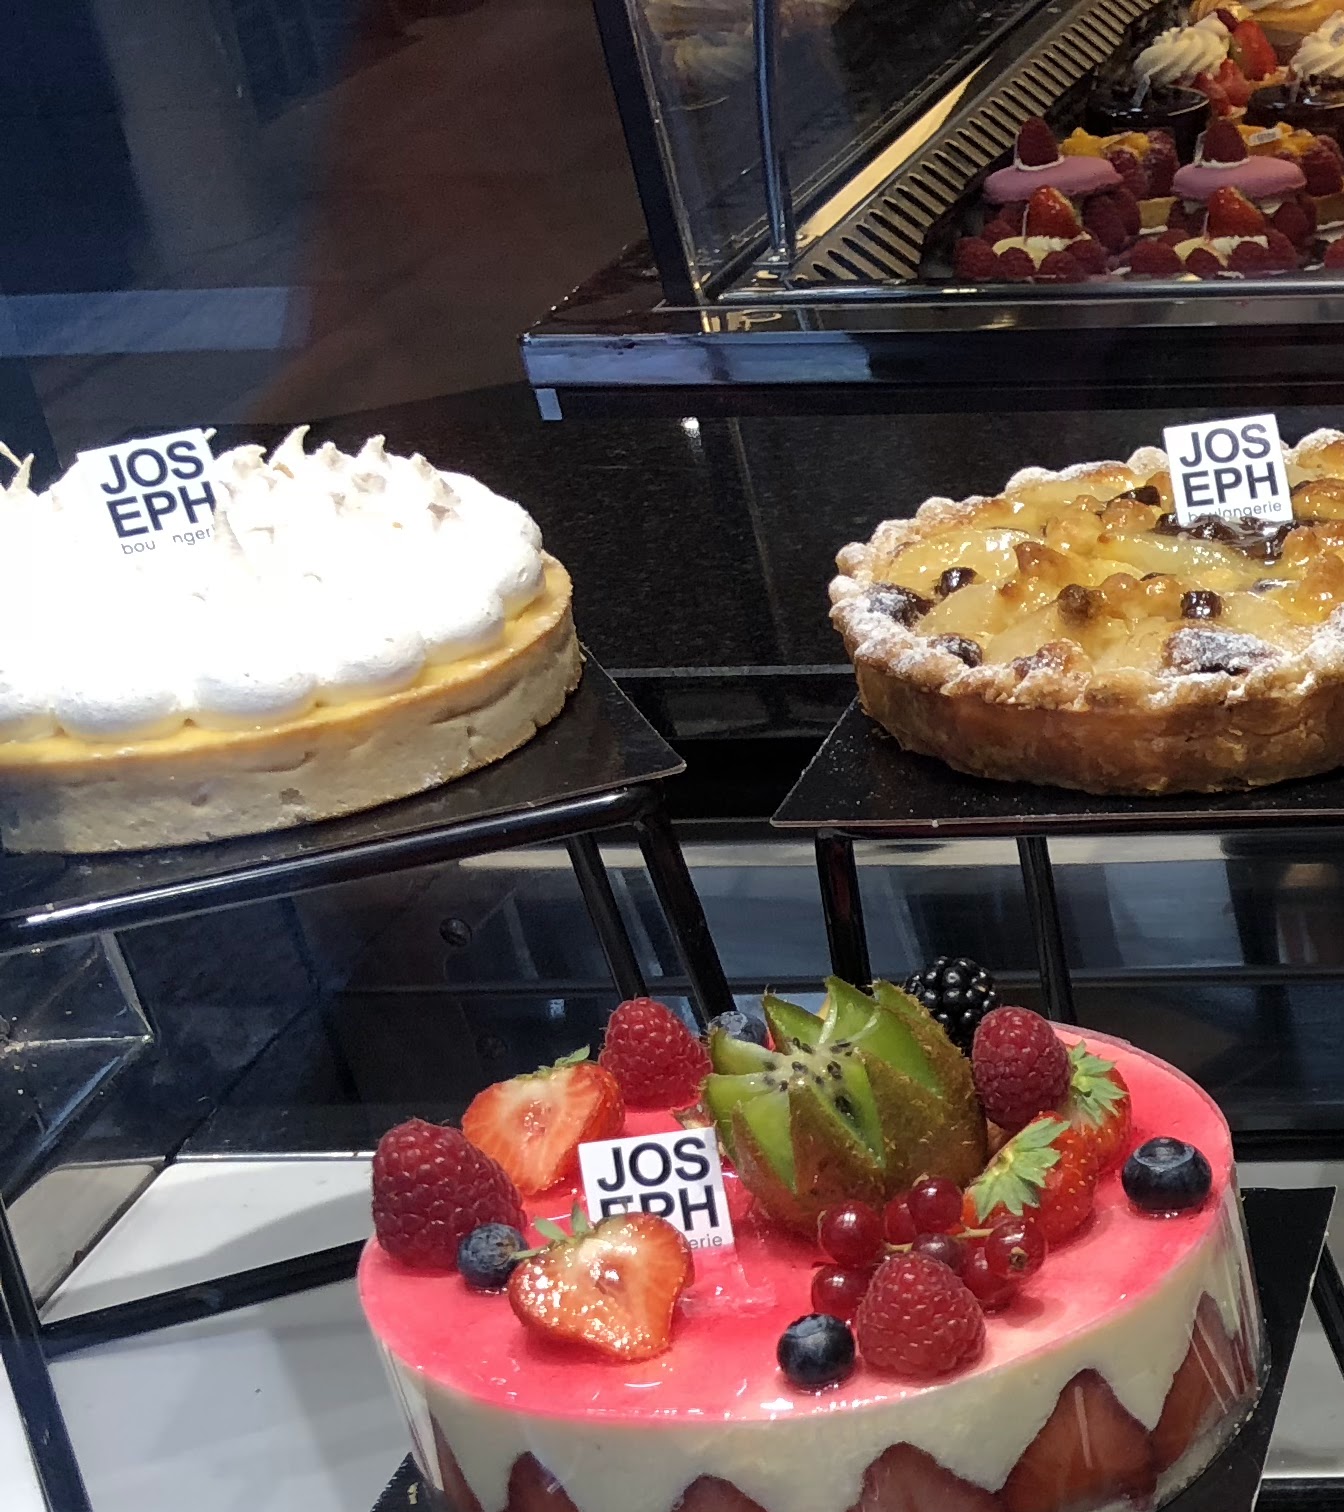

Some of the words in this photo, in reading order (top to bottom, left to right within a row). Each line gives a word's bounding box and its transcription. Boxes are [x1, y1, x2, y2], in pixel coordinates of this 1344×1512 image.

[100, 440, 204, 495] JOS
[1179, 423, 1271, 467] JOS
[106, 481, 216, 539] EPH
[1182, 461, 1279, 507] EPH
[597, 1136, 710, 1192] JOS
